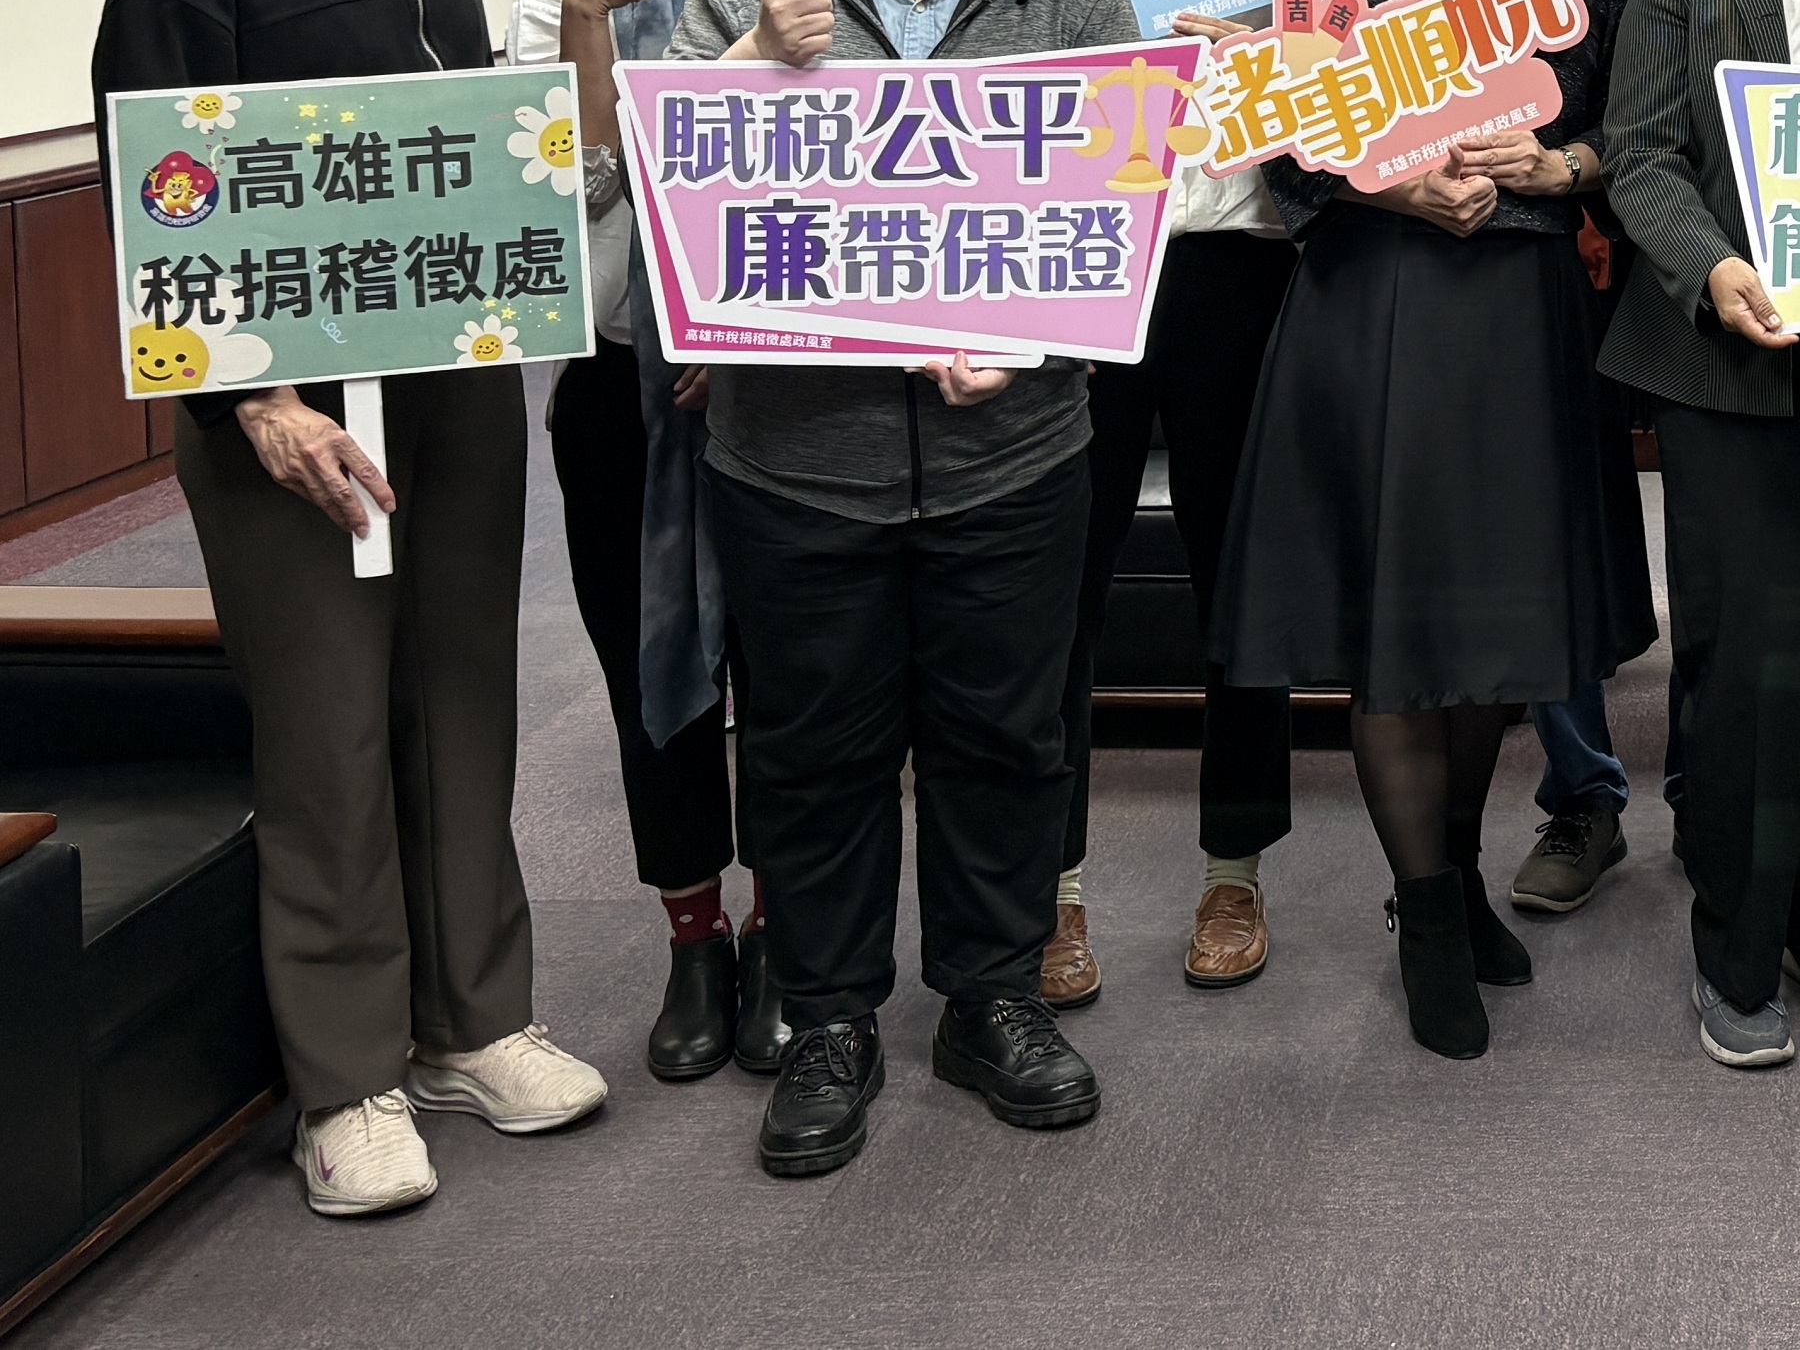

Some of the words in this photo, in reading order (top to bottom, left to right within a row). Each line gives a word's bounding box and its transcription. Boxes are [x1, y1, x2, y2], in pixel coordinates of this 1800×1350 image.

[1328, 4, 1354, 31] 吉
[223, 124, 477, 214] 高雄市
[140, 226, 570, 331] 稅捐稽徵處
[716, 197, 1129, 304] 廉帶保證
